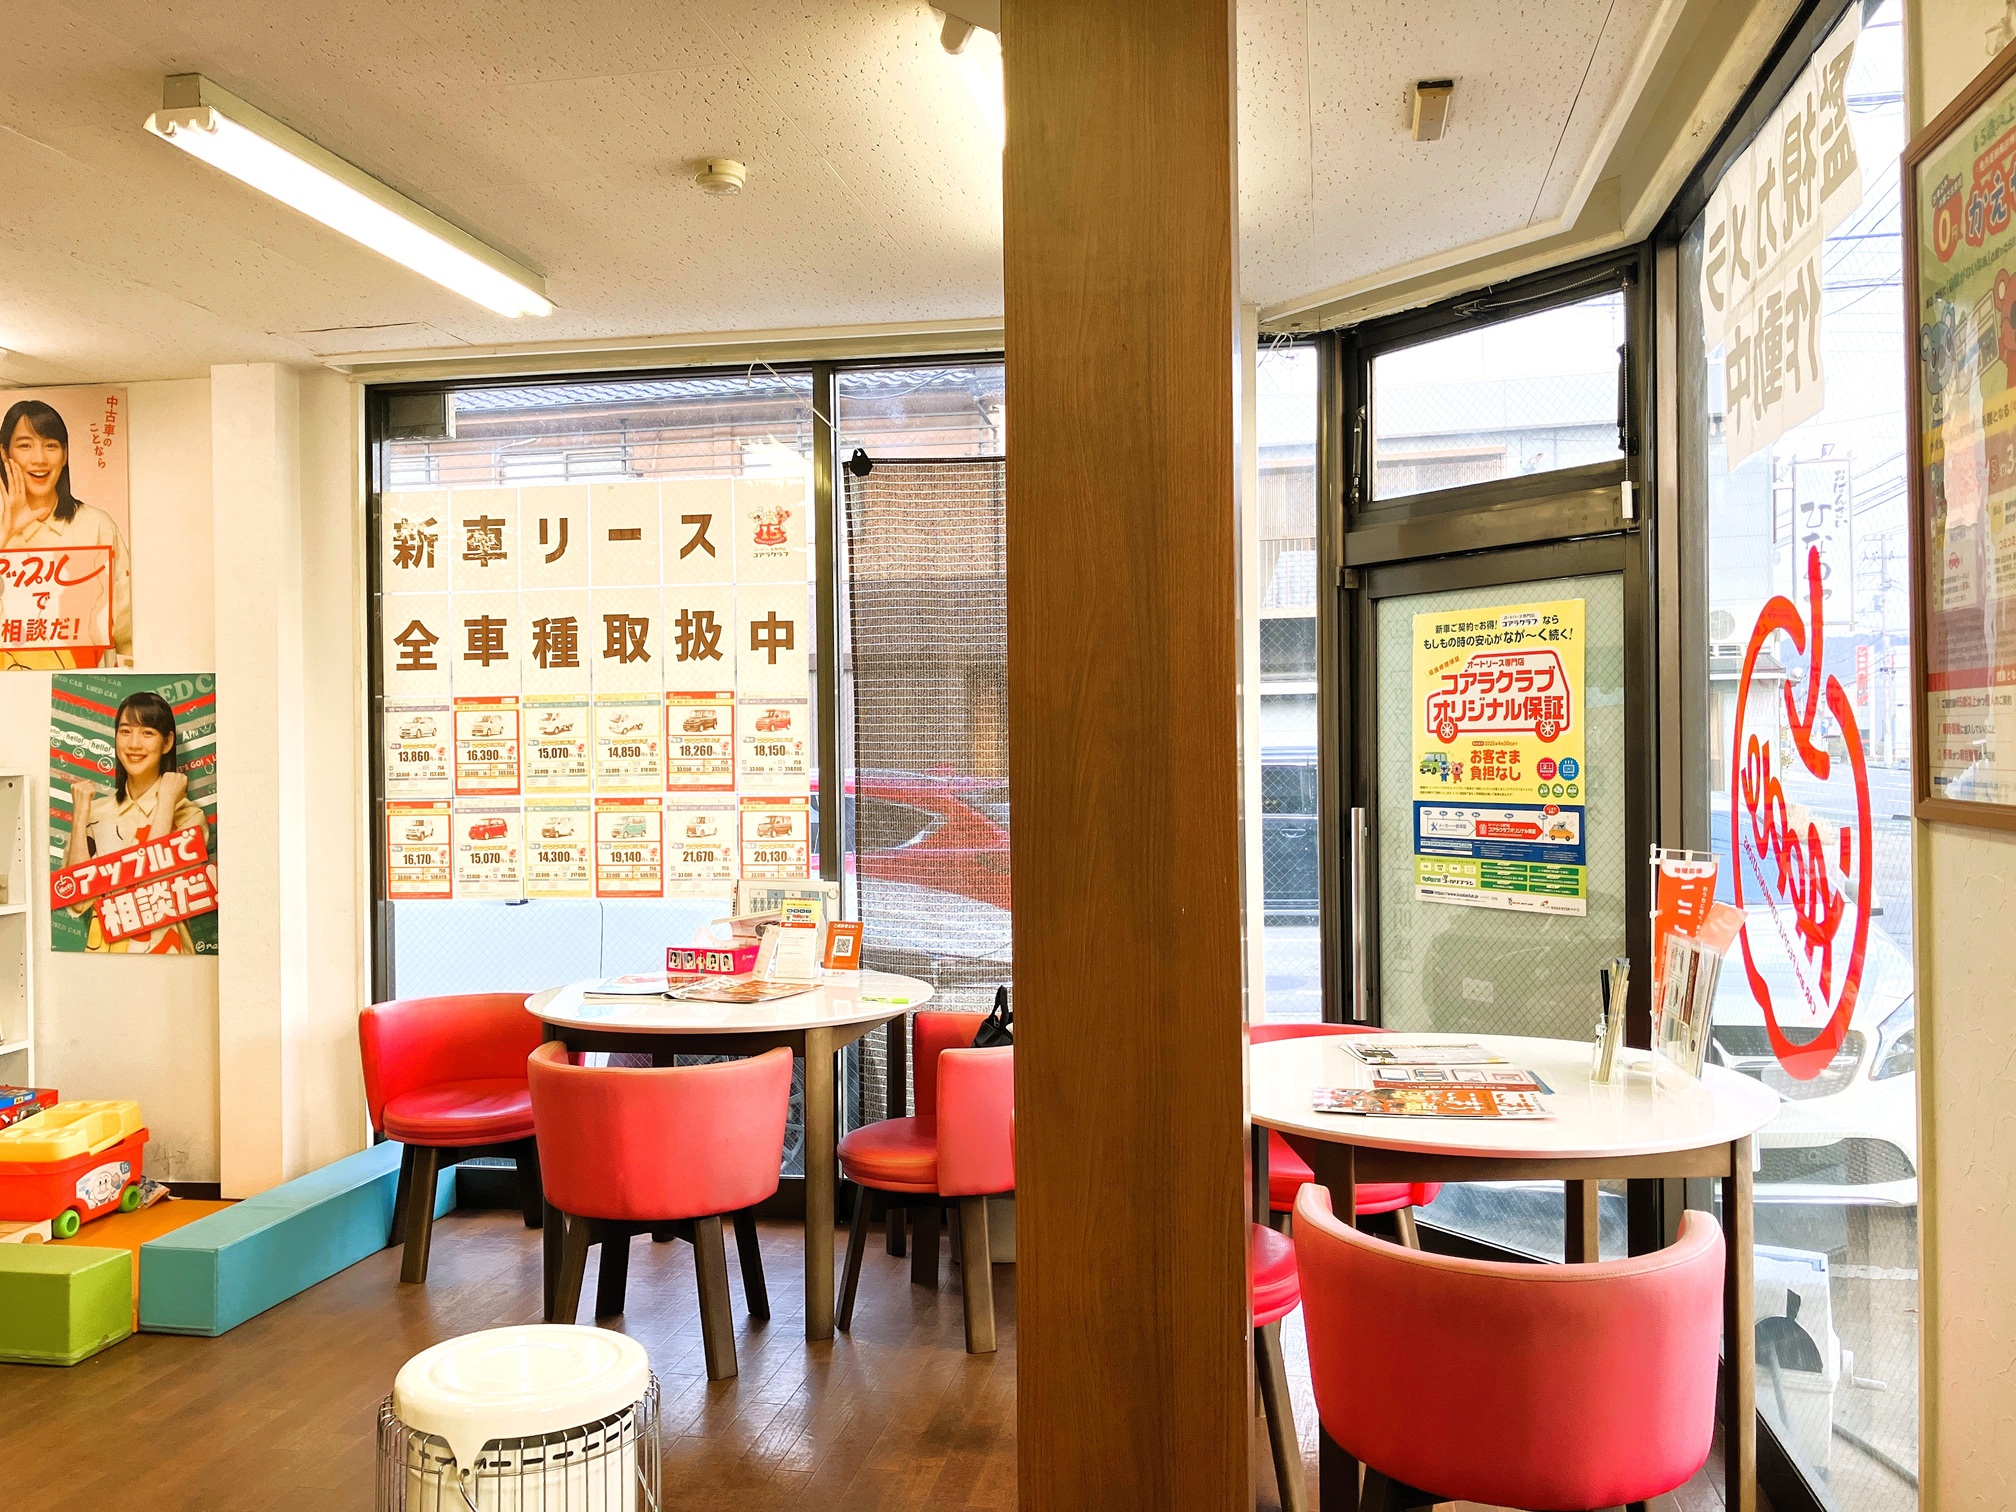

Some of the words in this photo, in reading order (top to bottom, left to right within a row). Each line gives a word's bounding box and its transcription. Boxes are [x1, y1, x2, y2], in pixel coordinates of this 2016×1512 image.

[102, 395, 119, 447] 中古車の
[89, 422, 106, 469] ことなら
[760, 525, 781, 540] 15
[392, 513, 716, 570] 新車リース
[32, 591, 50, 610] で
[1542, 614, 1560, 625] なら
[1, 618, 80, 643] 相談だ!
[393, 608, 795, 672] 全車種取扱中
[1467, 657, 1525, 669] オートリース専門店
[1440, 665, 1556, 696] コアラクラブ
[1433, 695, 1565, 723] オリジナル保証
[466, 750, 498, 761] 16,390
[538, 748, 568, 759] 15,070
[608, 746, 640, 758] 14,850
[680, 745, 712, 757] 18,260
[754, 744, 786, 756] 18,150
[1470, 748, 1520, 764] お客さま
[398, 751, 430, 762] 13,860
[1470, 766, 1521, 782] 負担なし
[72, 828, 198, 895] アップルで
[403, 854, 432, 865] 16,170
[470, 852, 500, 864] 15,070
[538, 851, 570, 862] 14,300
[610, 851, 642, 863] 19,140
[682, 851, 714, 862] 21,670
[754, 851, 788, 863] 20,130
[101, 864, 218, 938] 相談だ!
